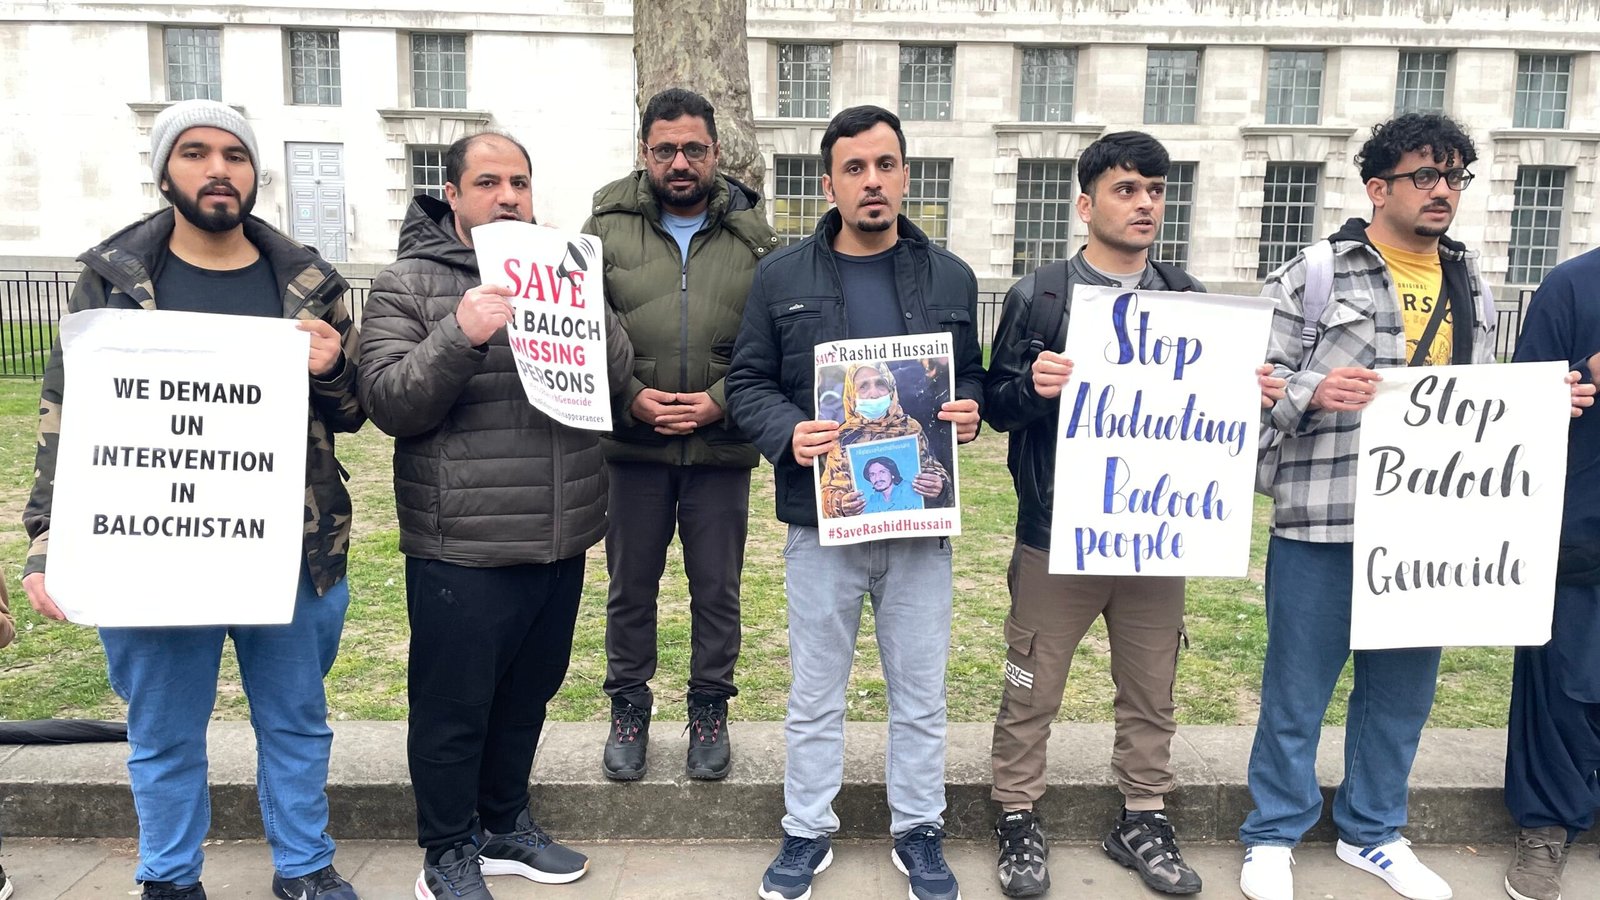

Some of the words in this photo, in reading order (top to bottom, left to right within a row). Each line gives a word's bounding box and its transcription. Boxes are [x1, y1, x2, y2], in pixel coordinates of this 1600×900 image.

[503, 257, 586, 309] SAVE
[1397, 282, 1428, 291] ORIGINAL
[1402, 293, 1434, 314] RS
[523, 309, 601, 341] BALOCH
[1104, 292, 1203, 381] Stop
[511, 336, 586, 367] MISSING
[816, 351, 837, 366] SAVE
[839, 344, 887, 362] Rashid
[892, 340, 949, 358] Hussain
[112, 377, 150, 400] WE
[159, 380, 262, 405] DEMAND
[518, 358, 595, 395] PERSONS
[1065, 381, 1247, 457] Abducting
[1403, 374, 1509, 443] Stop
[170, 414, 204, 437] UN
[92, 444, 274, 473] INTERVENTION
[1368, 444, 1542, 499] Baloch
[170, 482, 196, 504] IN
[1103, 456, 1232, 521] Baloch
[92, 513, 266, 540] BALOCHISTAN
[828, 518, 952, 540] #SaveRashidHussain
[1074, 521, 1185, 573] people
[1366, 540, 1527, 596] Genocide
